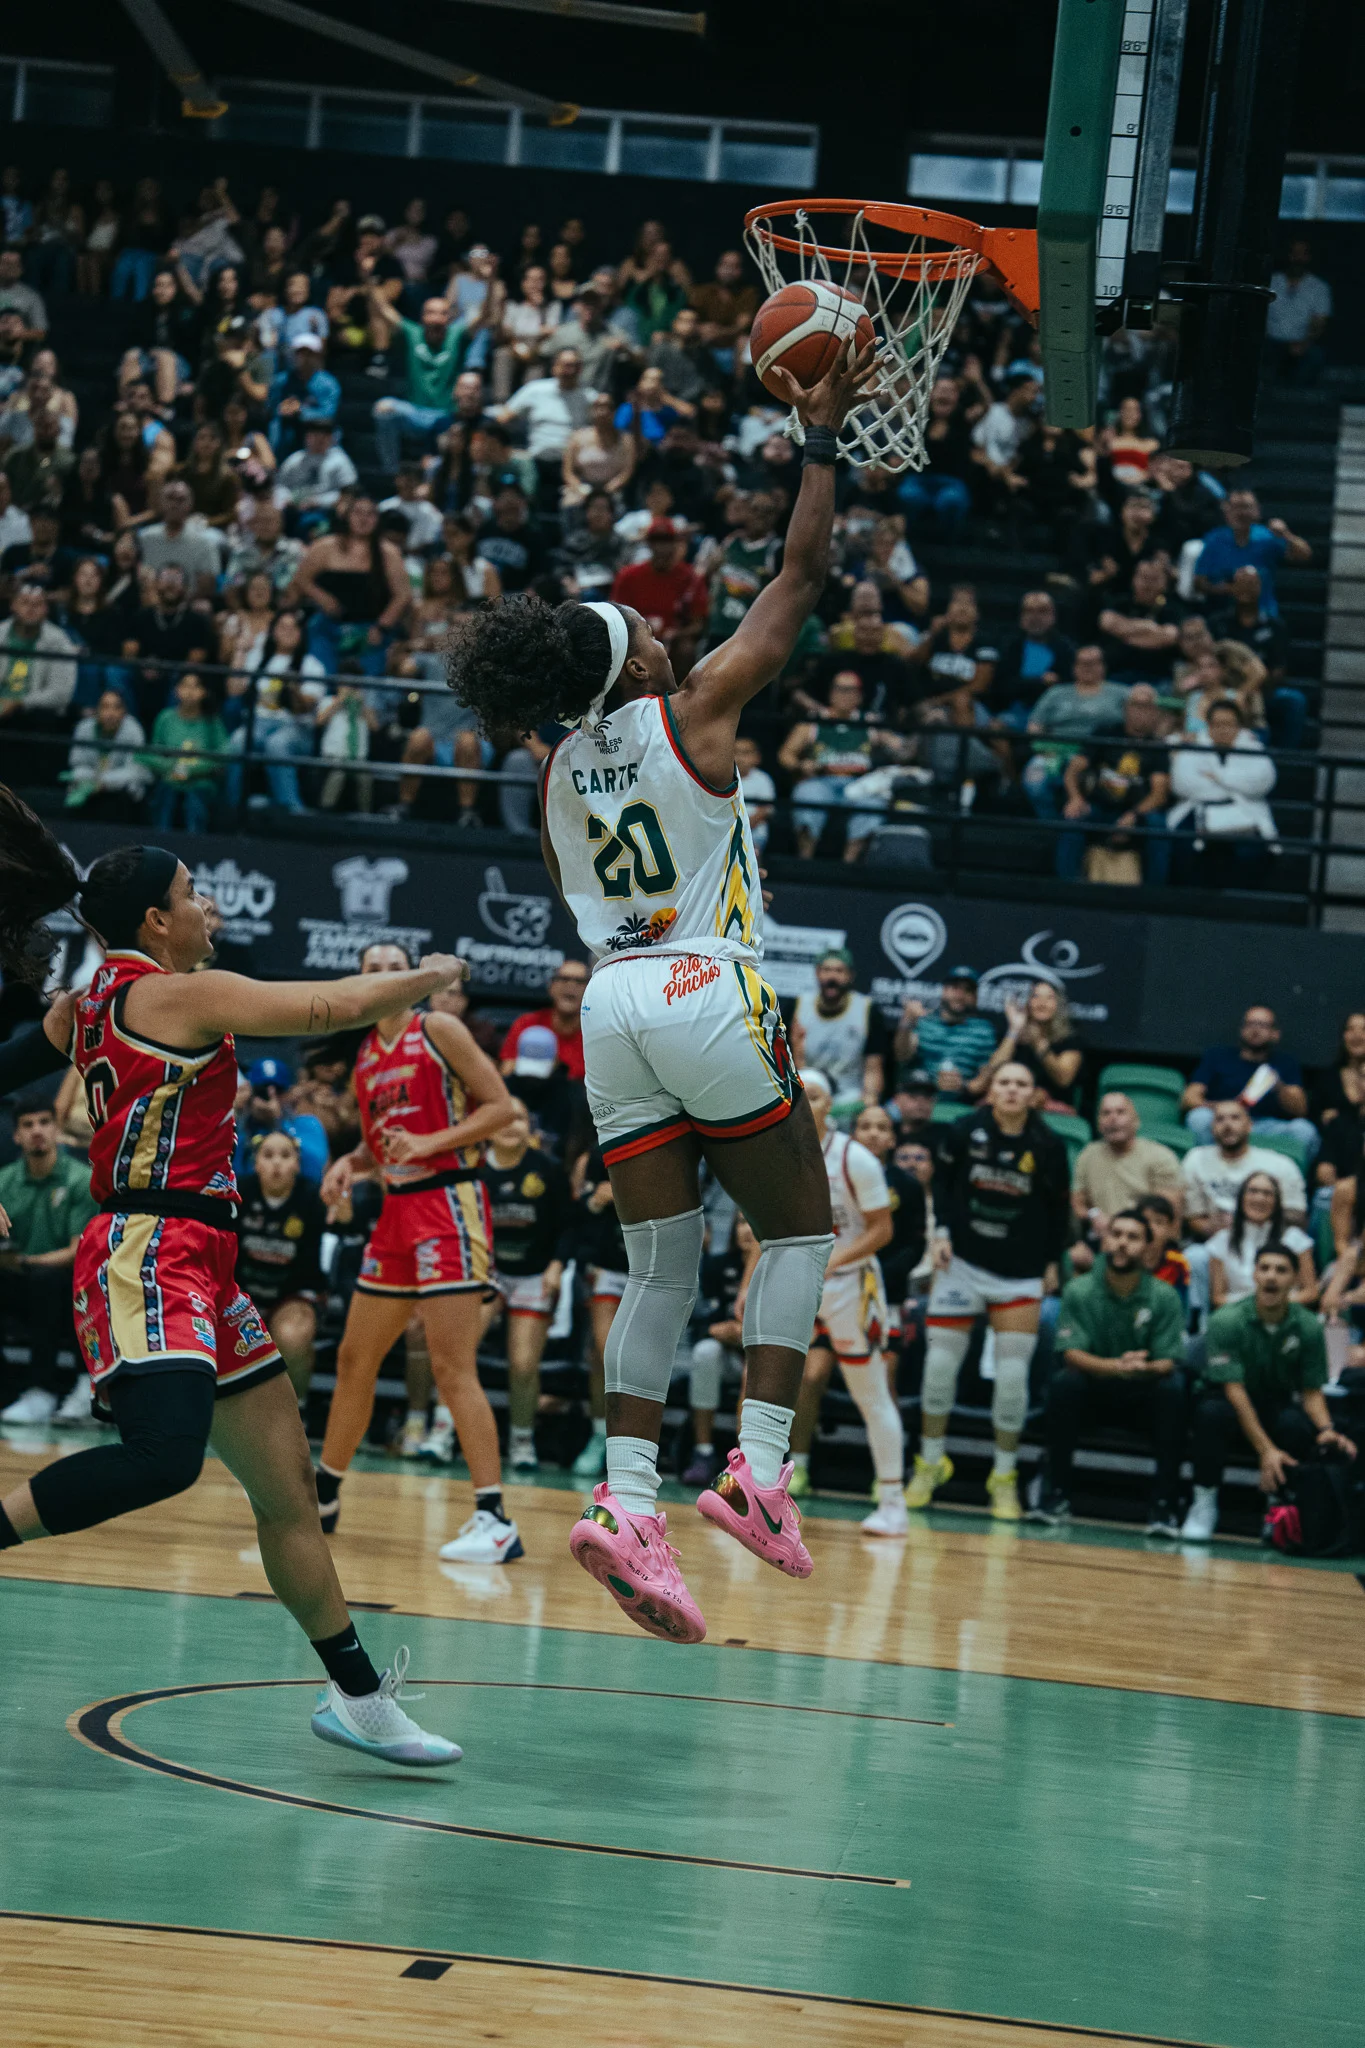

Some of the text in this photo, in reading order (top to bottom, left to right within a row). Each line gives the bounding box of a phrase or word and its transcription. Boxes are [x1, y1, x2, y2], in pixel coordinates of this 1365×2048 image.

[571, 762, 639, 796] CARTE
[584, 798, 681, 901] 20
[662, 963, 722, 1006] Pinchos
